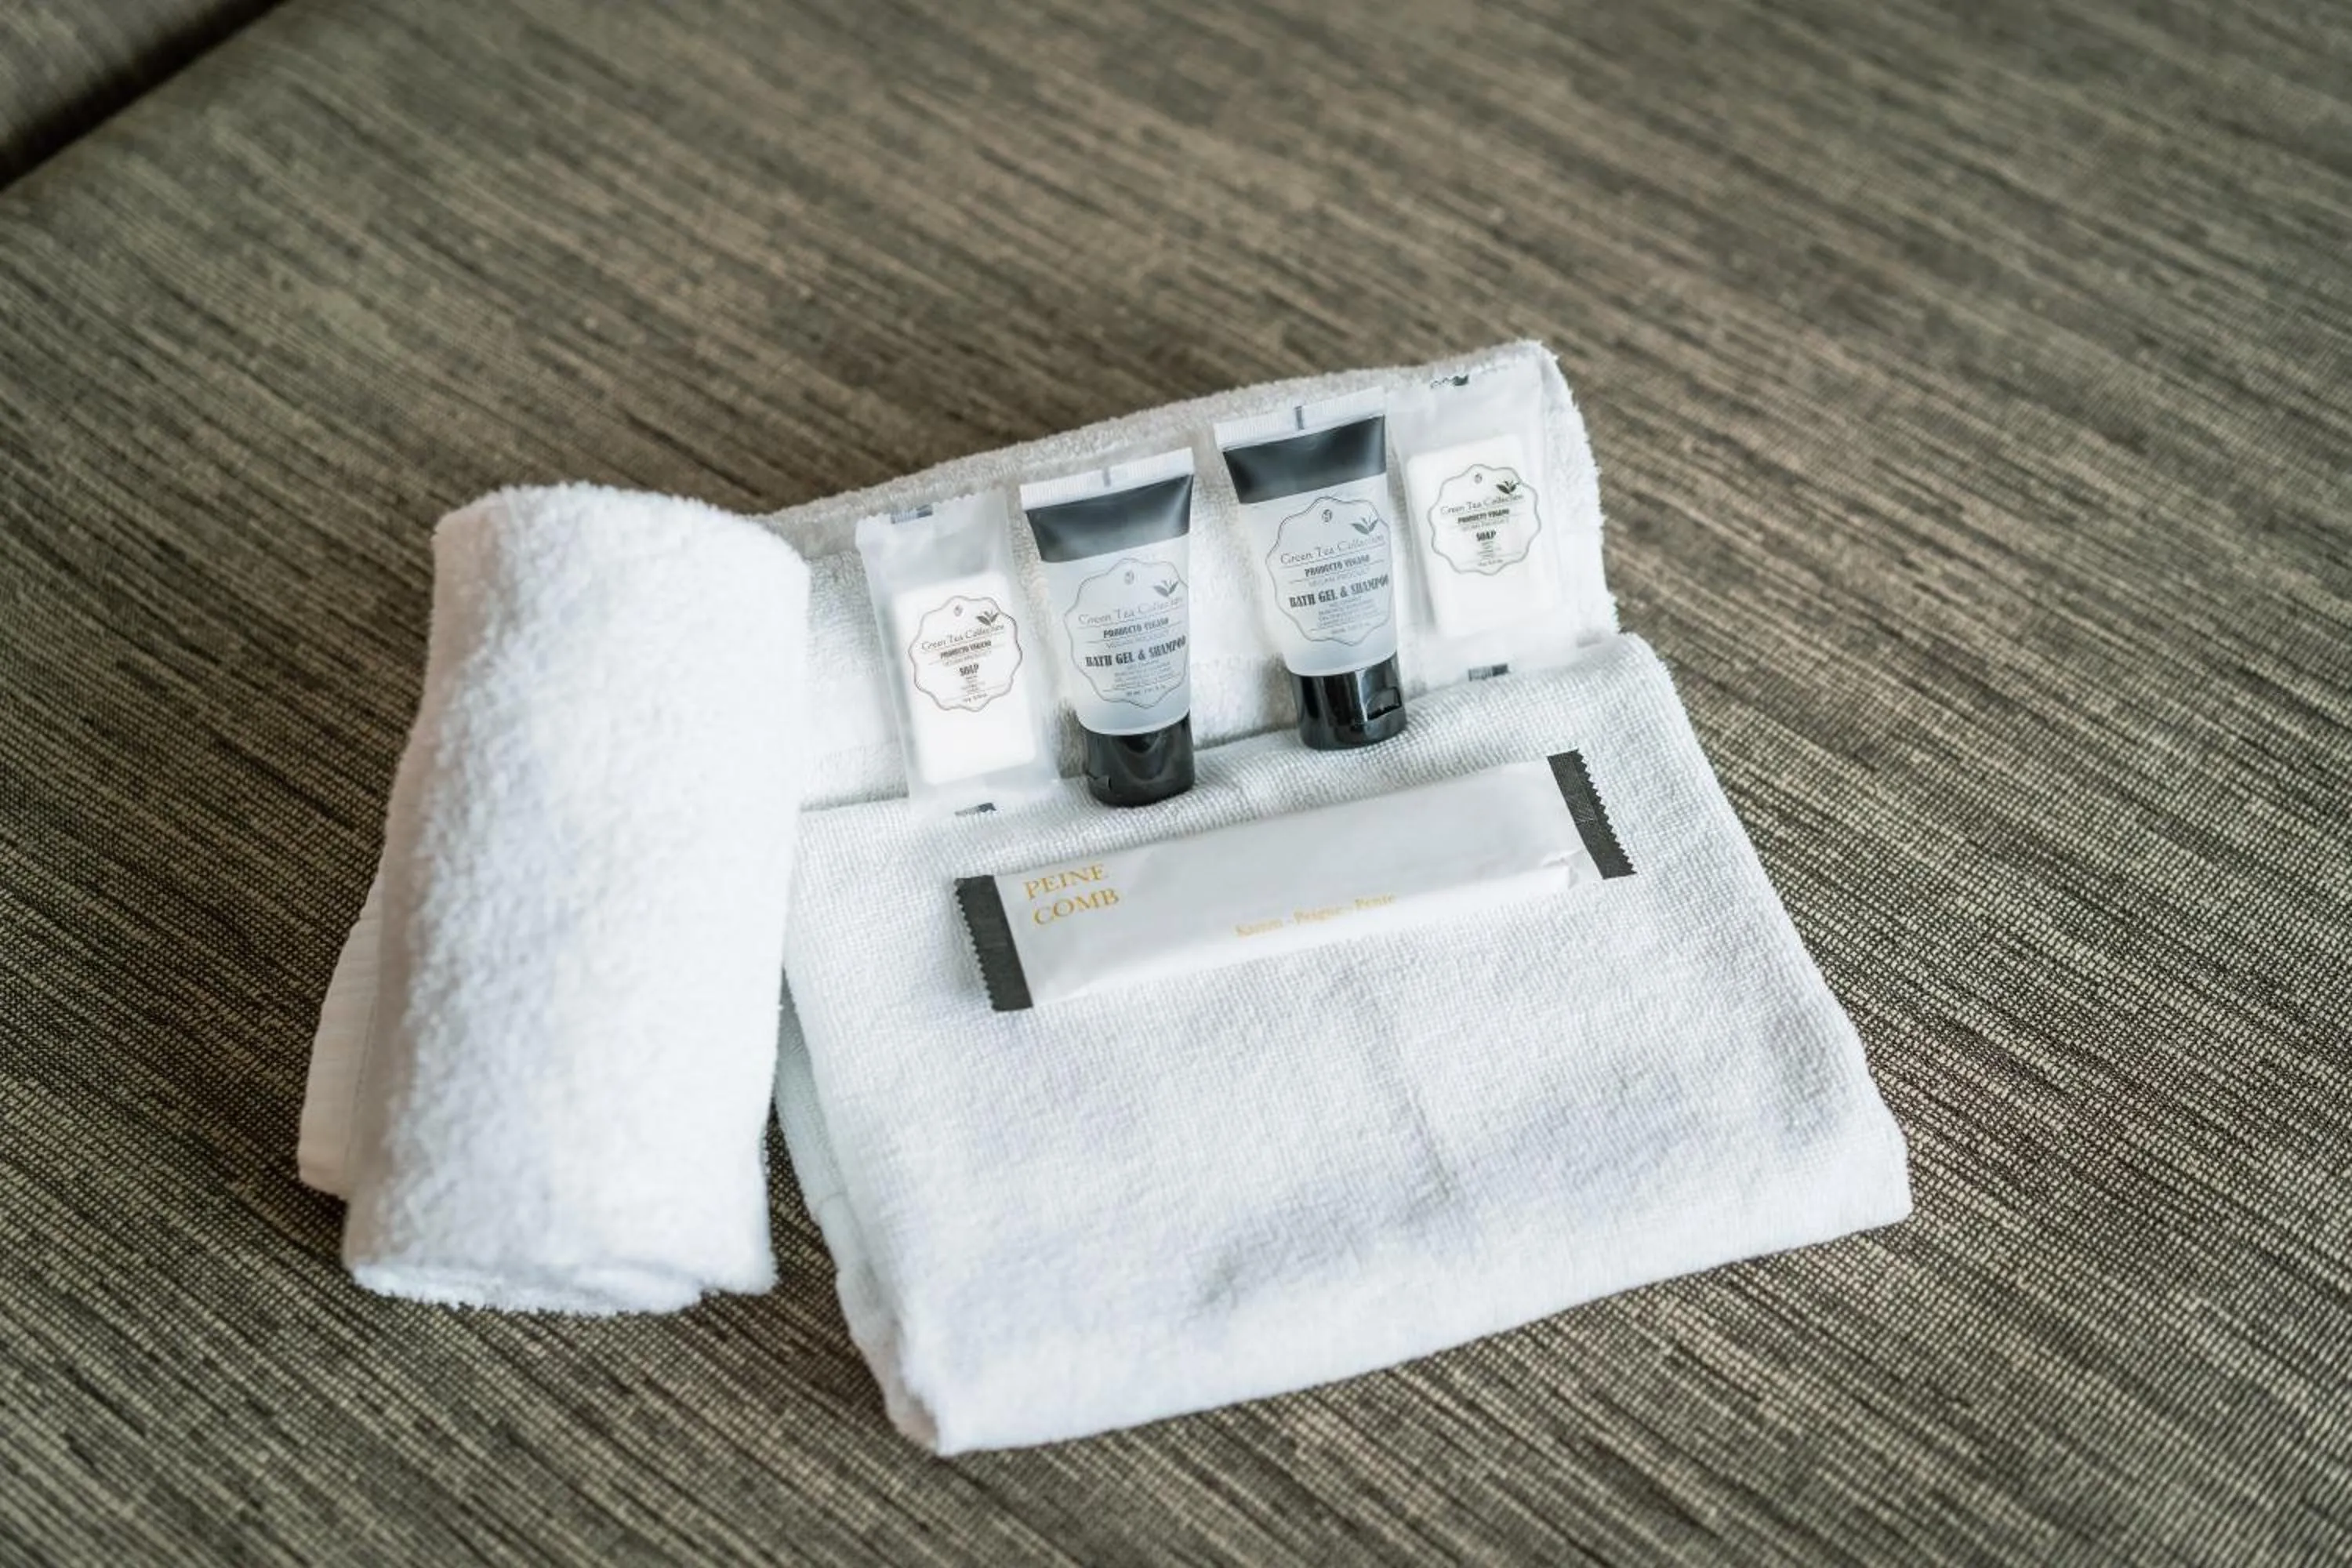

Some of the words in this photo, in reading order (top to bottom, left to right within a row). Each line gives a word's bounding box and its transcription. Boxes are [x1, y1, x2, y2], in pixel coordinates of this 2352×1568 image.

[1475, 530, 1497, 542] SOAP
[1280, 551, 1313, 564] Green
[1313, 546, 1334, 557] Tea
[1290, 593, 1316, 608] BATH
[1318, 589, 1337, 603] GEL
[1340, 586, 1348, 598] &
[1351, 573, 1389, 593] SHAMPOO
[1078, 614, 1112, 625] Green
[1113, 608, 1135, 619] Tea
[1086, 655, 1112, 666] BATH
[1116, 652, 1135, 664] GEL
[1138, 649, 1146, 660] &
[1149, 635, 1186, 658] SHAMPOO
[959, 664, 979, 676] SOAP
[1023, 863, 1105, 900] PEINE
[1033, 888, 1120, 925] COMB
